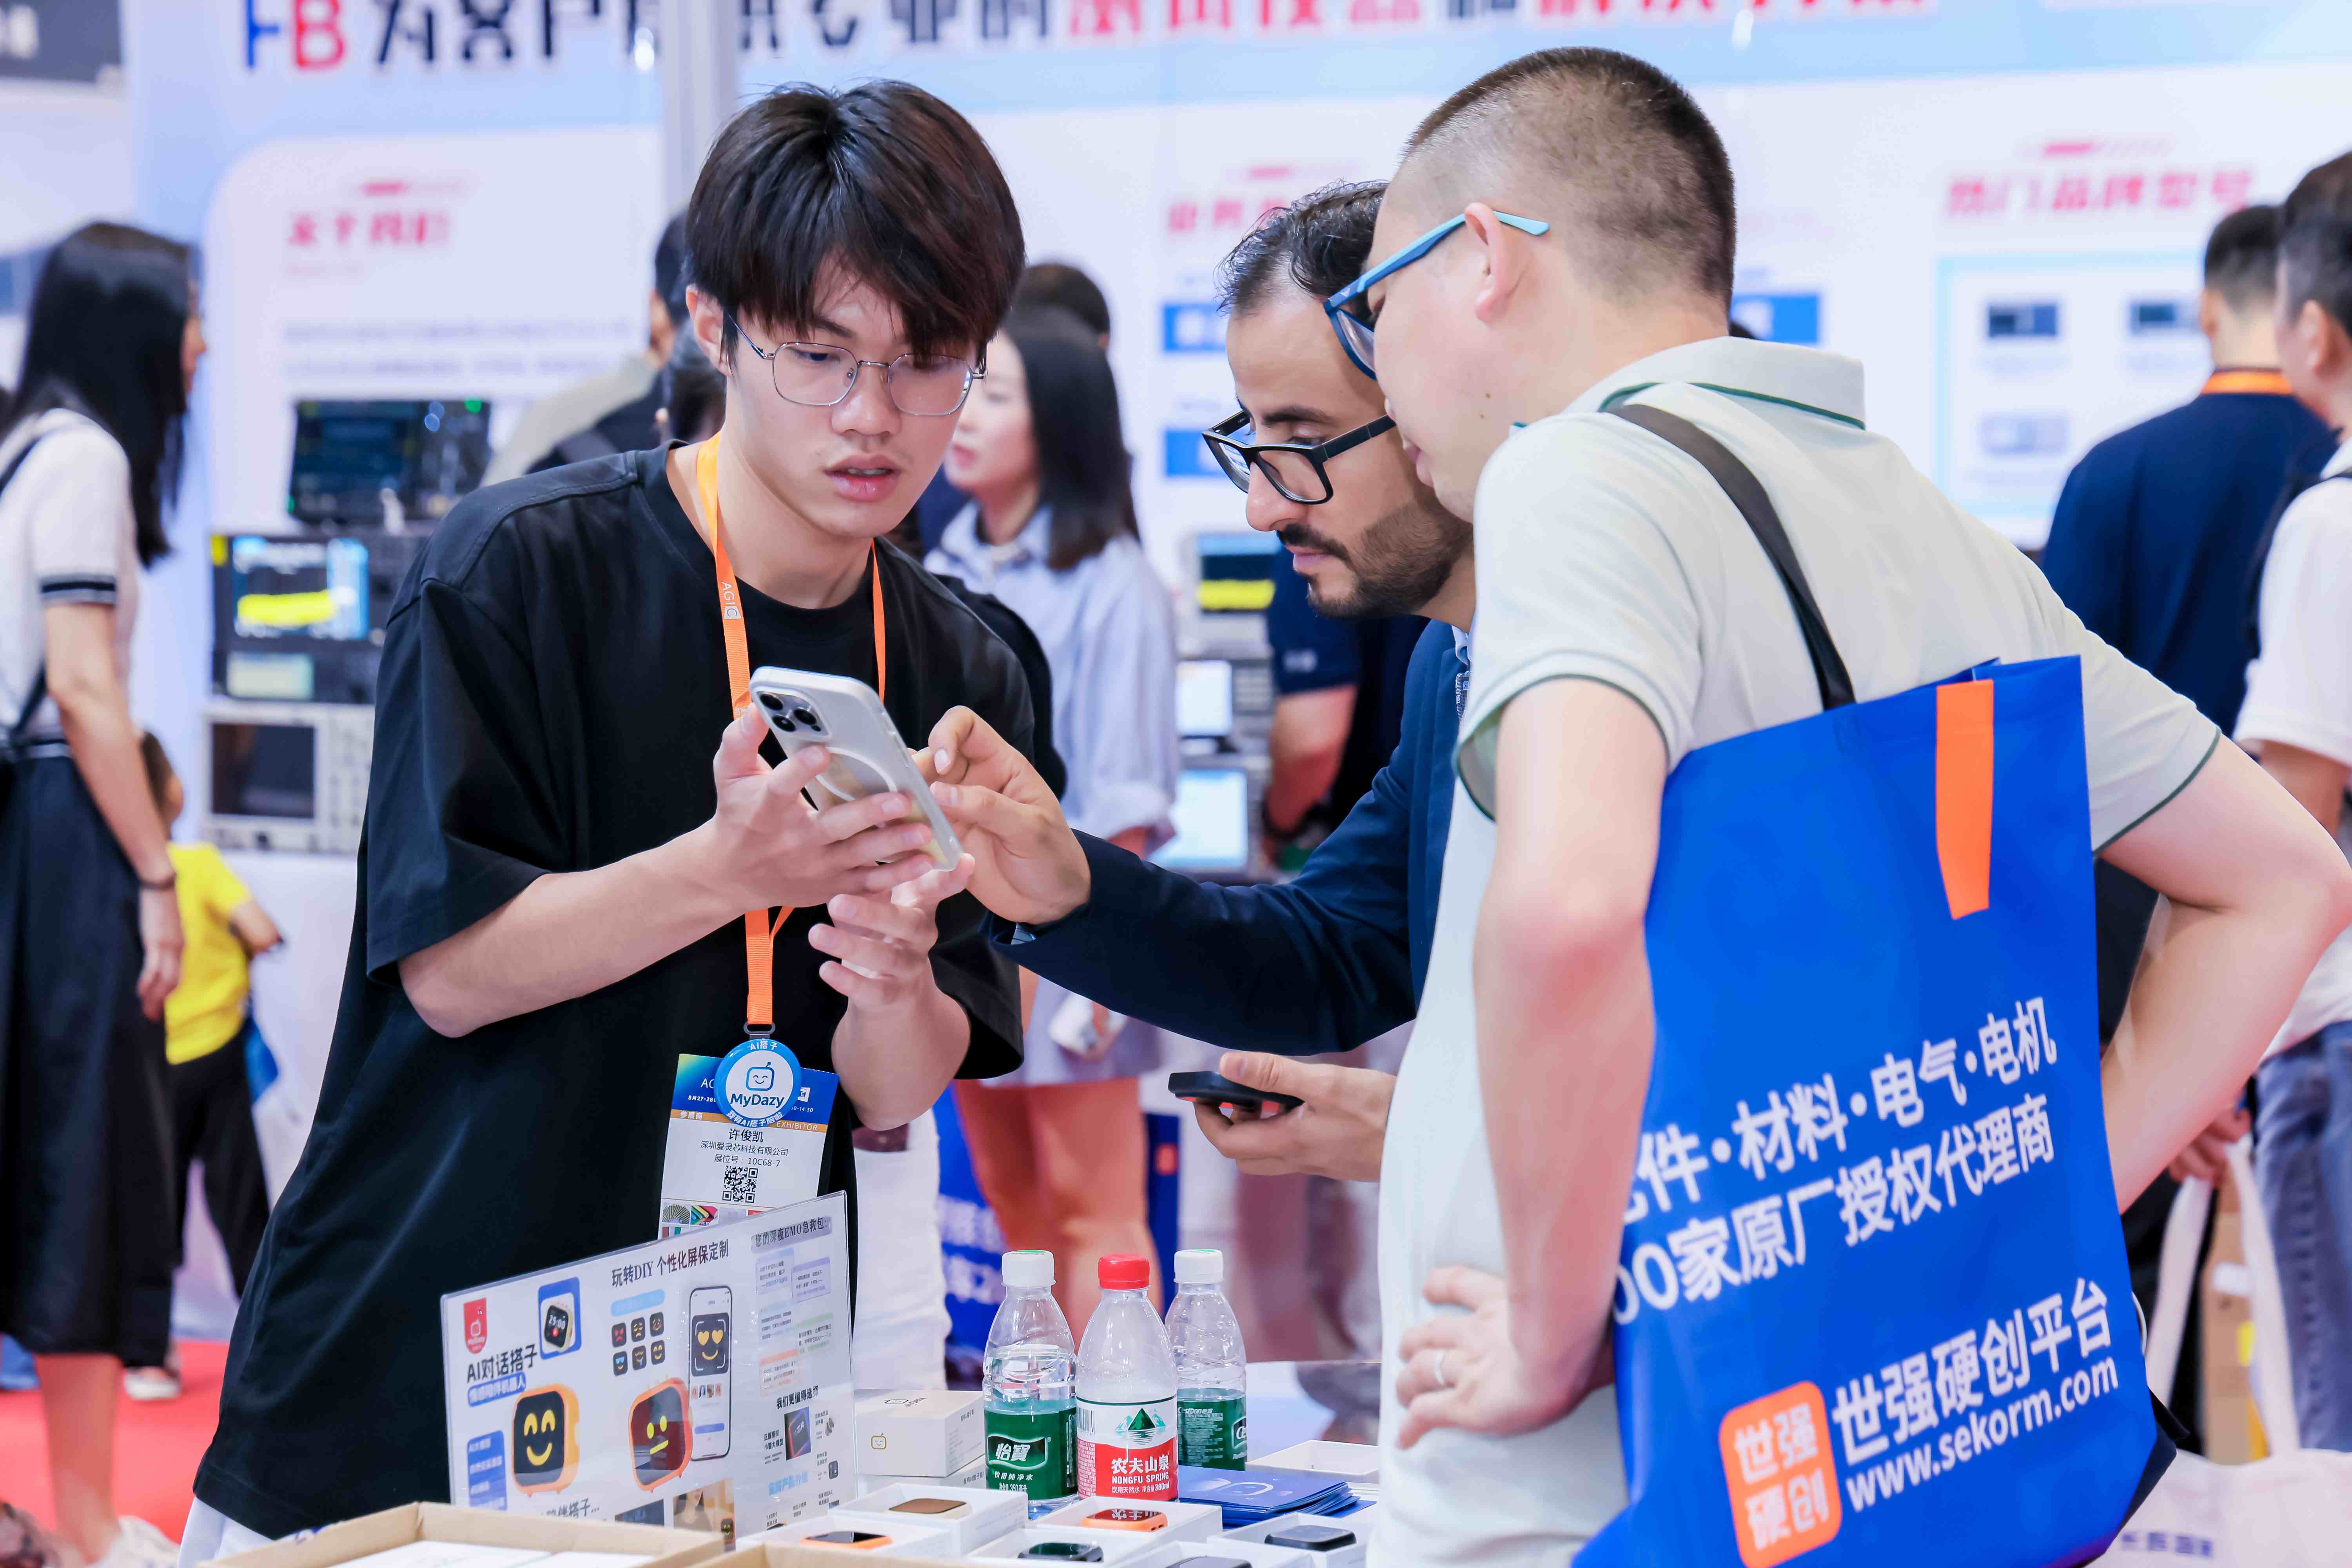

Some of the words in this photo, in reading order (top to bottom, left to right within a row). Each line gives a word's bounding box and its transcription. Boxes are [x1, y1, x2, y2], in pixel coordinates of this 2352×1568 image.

[721, 581, 742, 619] AGIC
[750, 1039, 779, 1051] AI搭子
[688, 1094, 717, 1103] 8月27-28
[730, 1093, 784, 1109] MyDazy
[680, 1111, 703, 1120] 参展商
[776, 1120, 818, 1131] EXHIBITOR
[729, 1128, 764, 1143] 许俊凯
[700, 1140, 788, 1157] 深圳爱灵芯科技有限公司
[467, 1343, 538, 1383] AI对话搭子
[1831, 1277, 2111, 1466] 世强硬创平台
[776, 1385, 818, 1409] 我们更值得选择
[1733, 1401, 1819, 1485] 世强
[1845, 1356, 2119, 1513] www.sekorm.com
[995, 1443, 1031, 1462] 怡寶
[1111, 1454, 1169, 1475] 农夫山泉
[994, 1470, 1034, 1481] 饮用纯净水
[1112, 1475, 1143, 1485] NONGFU
[1146, 1472, 1169, 1482] SPRING
[1111, 1486, 1140, 1494] 饮用天然水
[1744, 1466, 1830, 1551] 硬创
